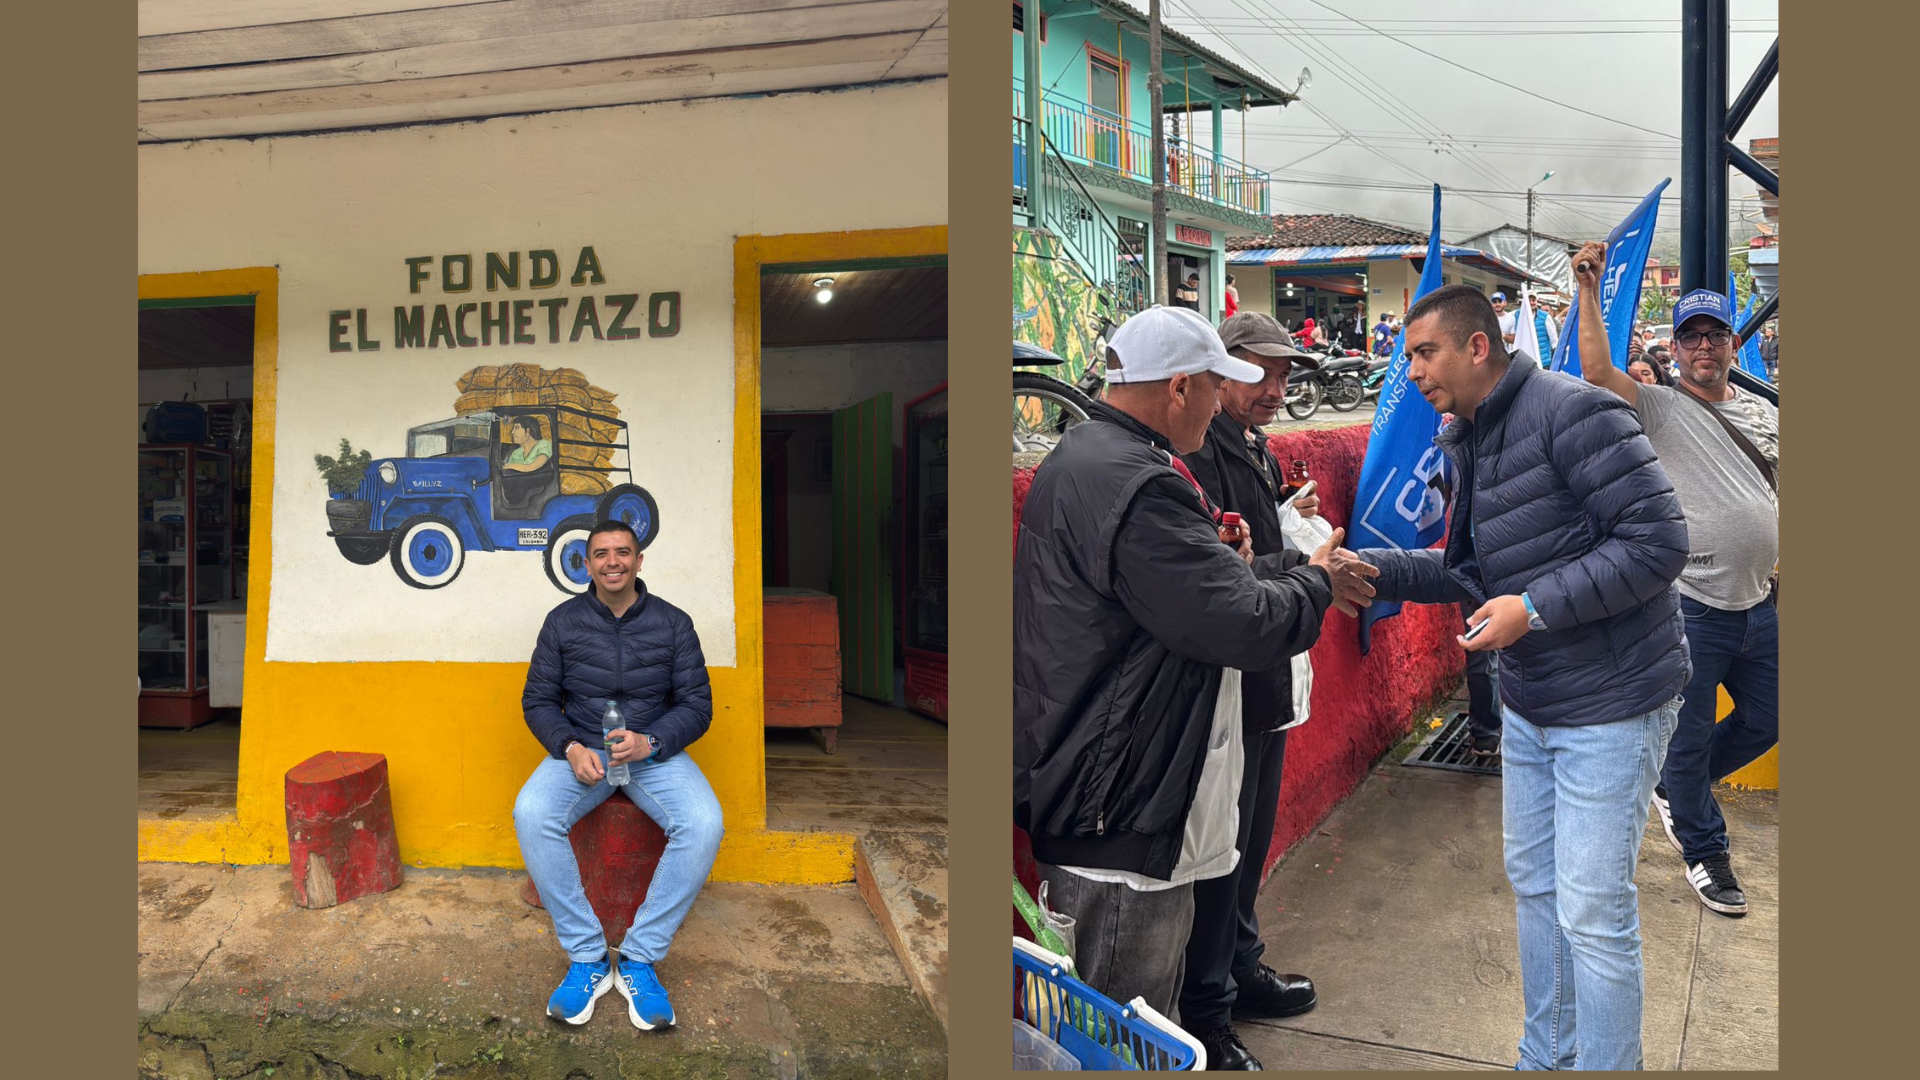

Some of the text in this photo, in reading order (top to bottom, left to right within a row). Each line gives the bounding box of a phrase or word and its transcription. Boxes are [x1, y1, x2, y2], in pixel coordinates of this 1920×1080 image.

[405, 246, 606, 293] FONDA
[329, 291, 682, 353] EL MACHETAZO
[1679, 294, 1720, 308] CRISTIAN
[1387, 343, 1408, 385] LLEG
[519, 530, 547, 539] HER-392
